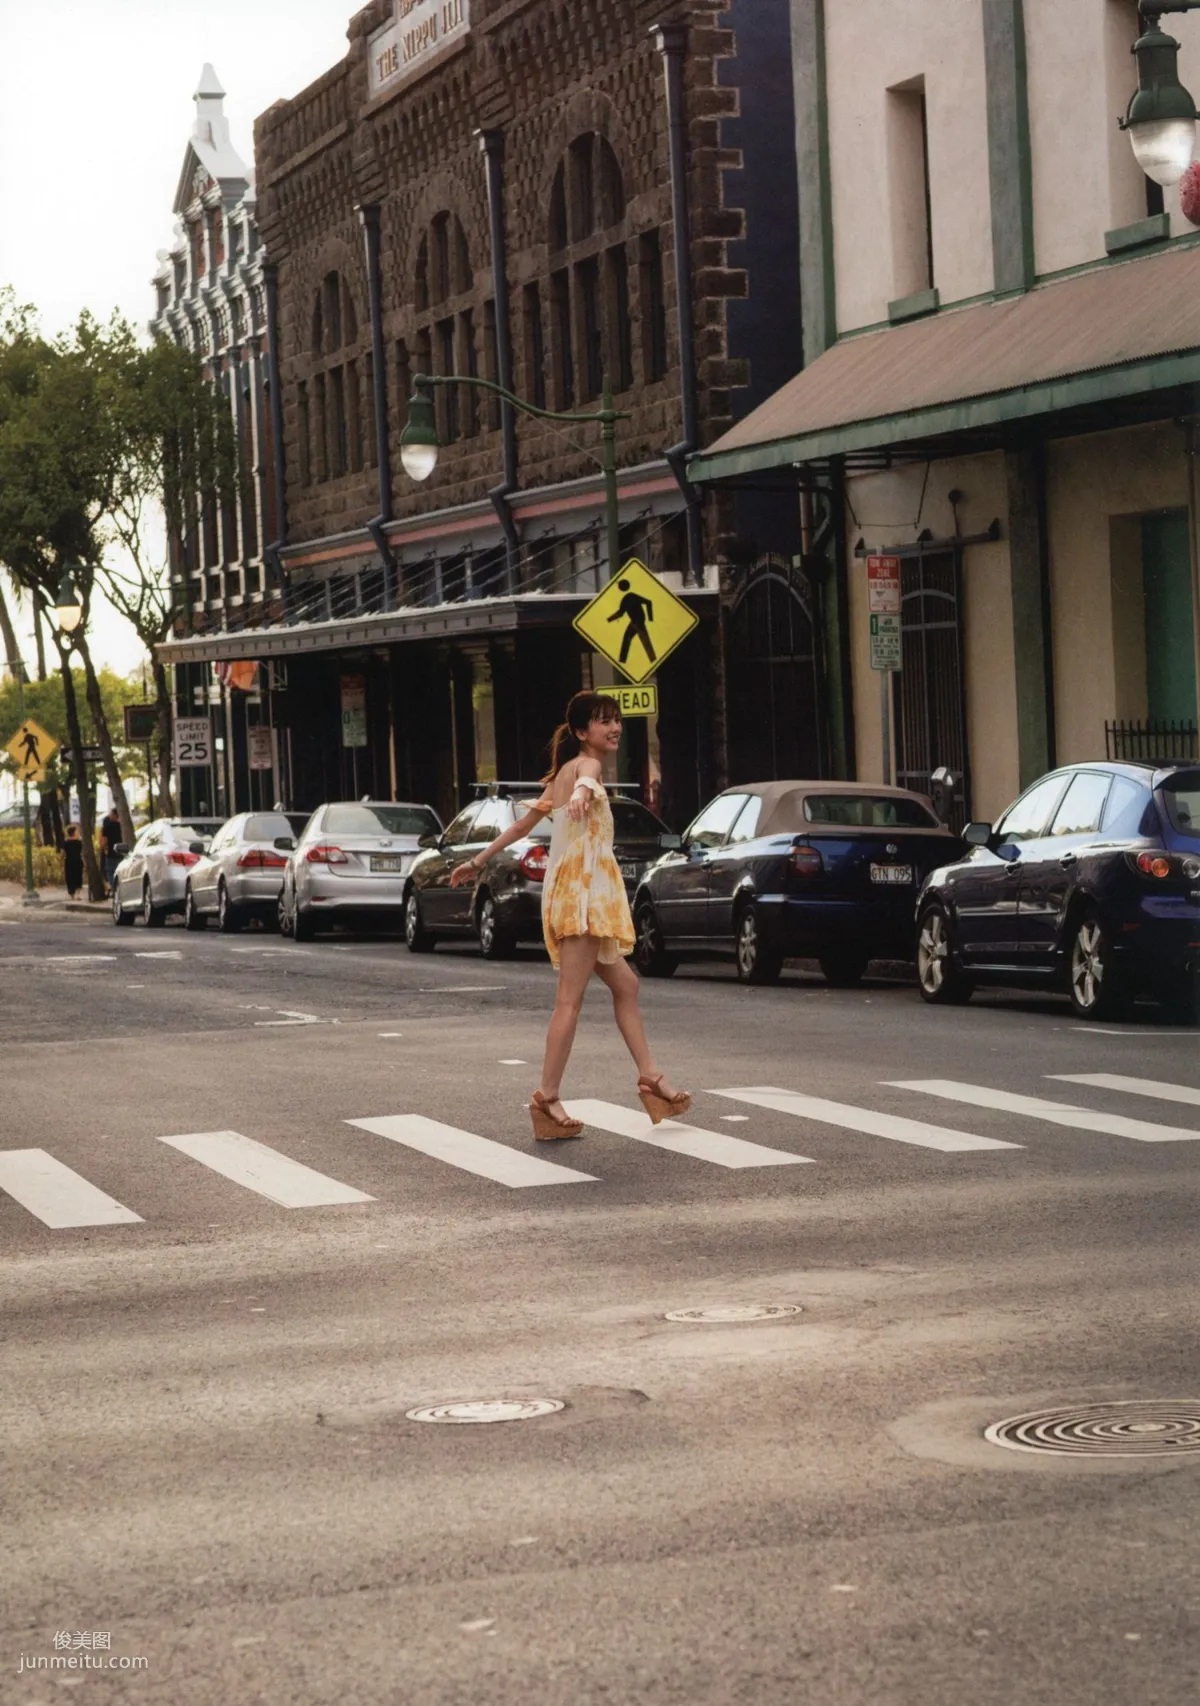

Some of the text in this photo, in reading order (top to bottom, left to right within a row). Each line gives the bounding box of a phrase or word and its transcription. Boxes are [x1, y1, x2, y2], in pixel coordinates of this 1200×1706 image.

[376, 43, 399, 81] THE
[402, 12, 437, 63] NIPPU
[176, 722, 209, 731] SPEED
[180, 732, 204, 741] LIMIT
[178, 742, 208, 760] 25
